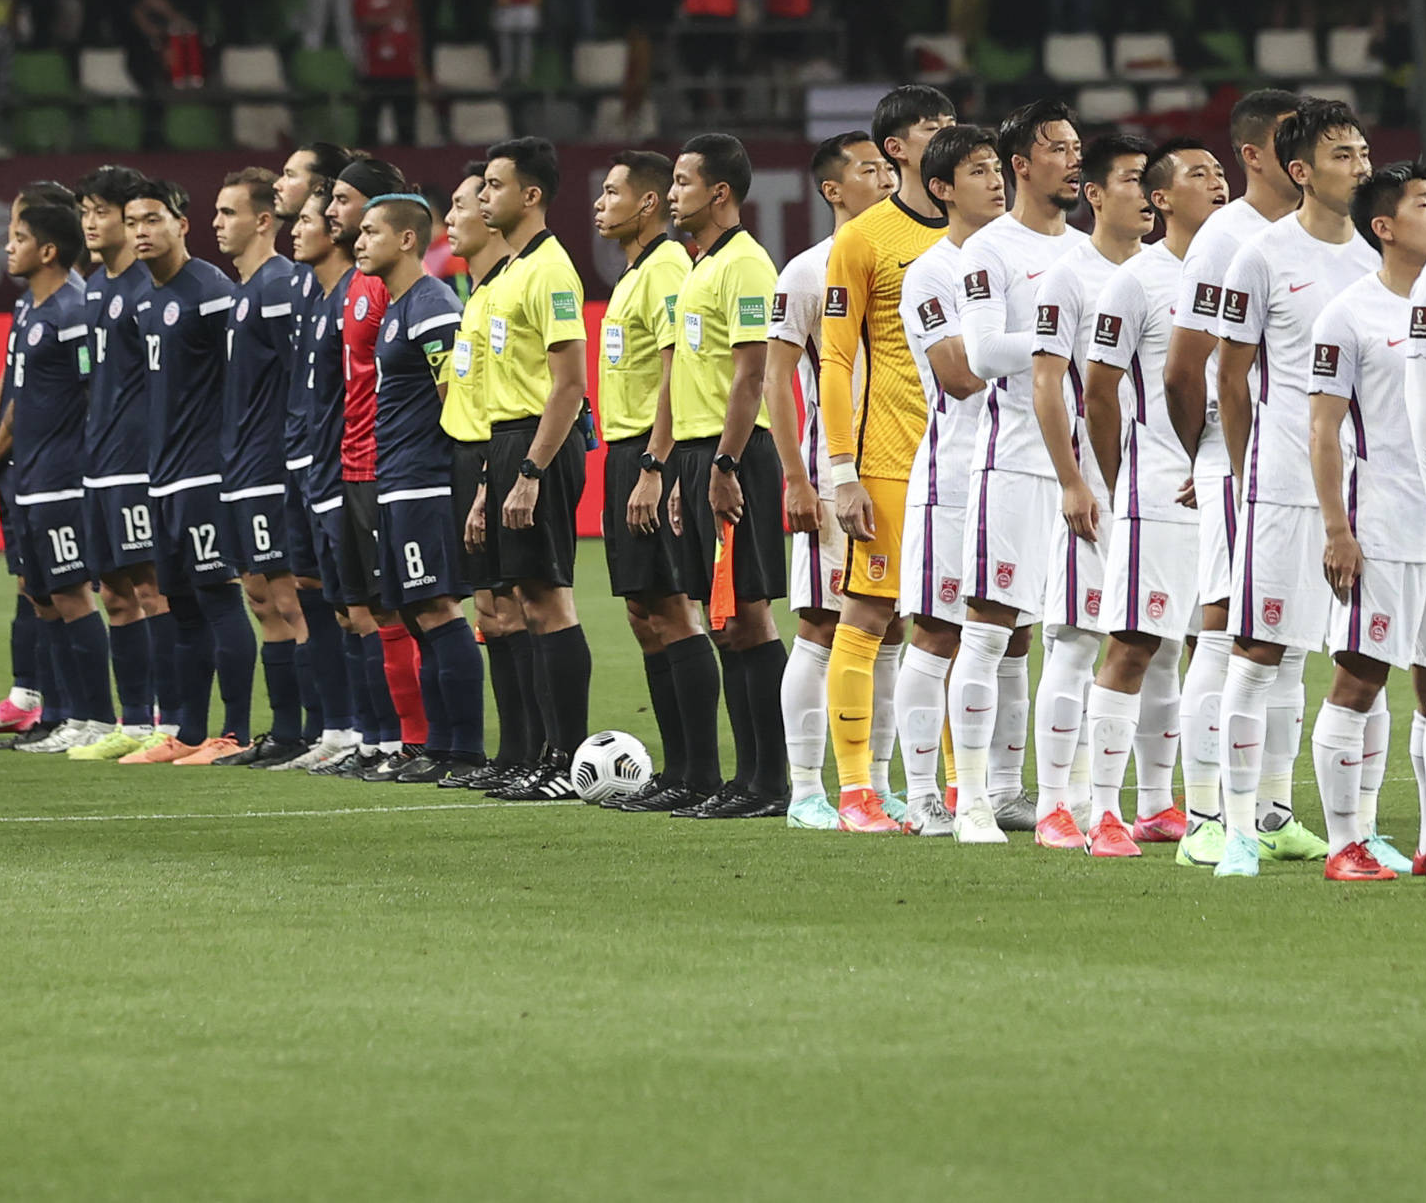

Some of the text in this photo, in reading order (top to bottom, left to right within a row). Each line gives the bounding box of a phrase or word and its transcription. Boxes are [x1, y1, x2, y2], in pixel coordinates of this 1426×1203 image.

[606, 328, 620, 338] FIFA
[686, 315, 698, 326] FIFA
[121, 505, 152, 542] 19
[253, 514, 270, 551] 6
[48, 526, 79, 563] 16
[188, 524, 220, 561] 12
[404, 541, 425, 579] 8
